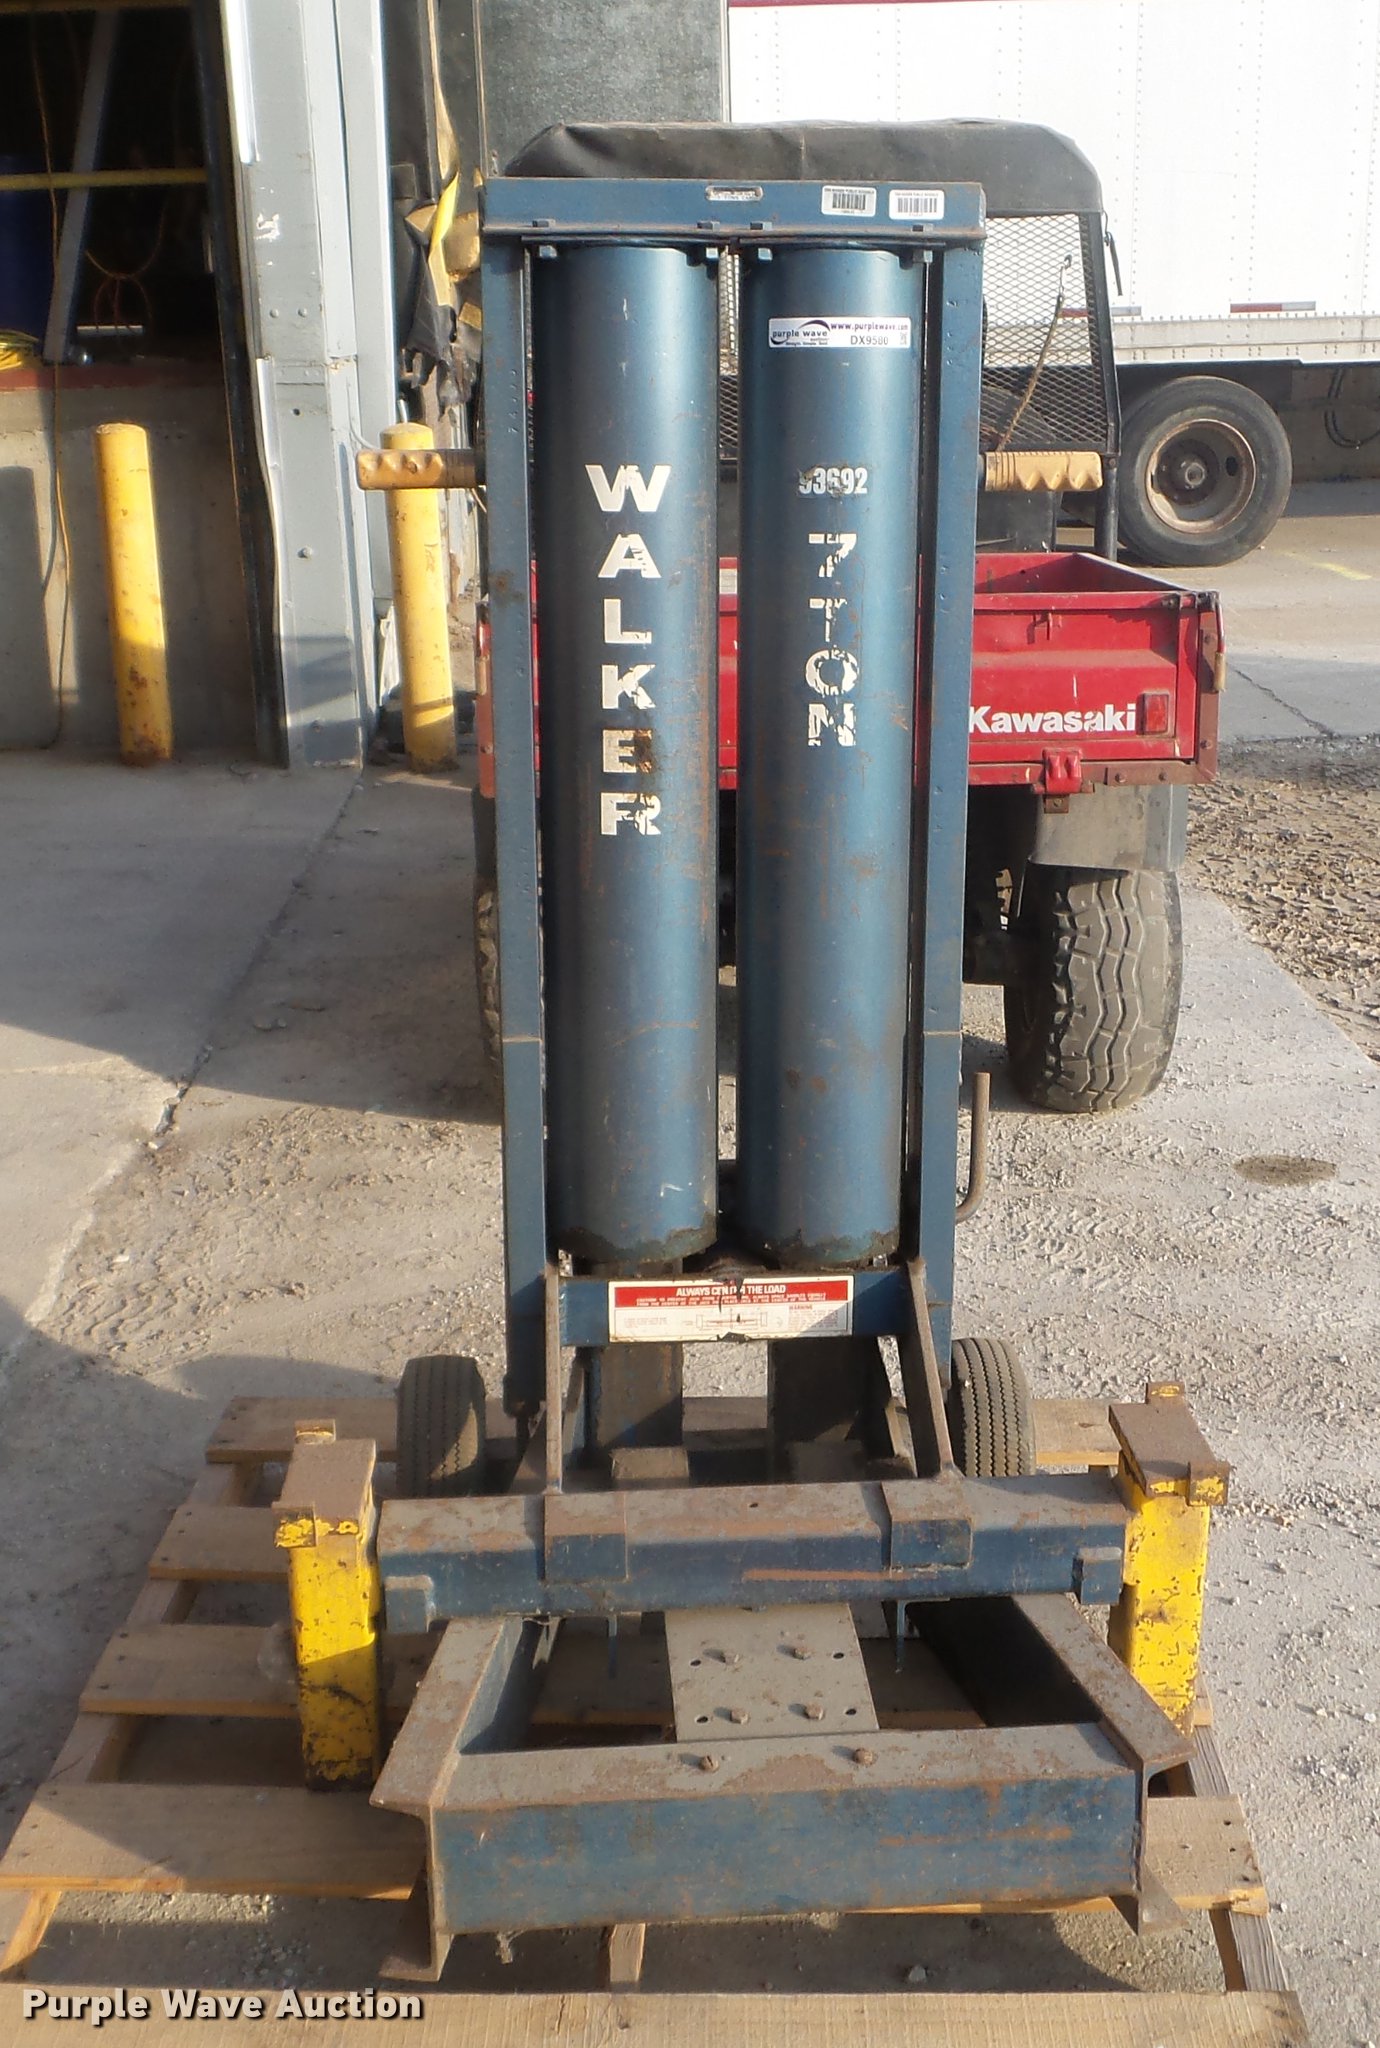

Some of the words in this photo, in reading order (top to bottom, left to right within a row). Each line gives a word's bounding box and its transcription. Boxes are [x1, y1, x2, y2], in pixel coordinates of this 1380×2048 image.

[830, 322, 908, 331] www.purplewave.com
[772, 329, 800, 338] purple
[802, 329, 828, 337] wave
[585, 464, 672, 836] WALKER
[969, 703, 1136, 734] Kawasaki
[676, 1287, 710, 1296] ALWAYS
[747, 1285, 763, 1294] THE
[764, 1284, 786, 1294] LOAD
